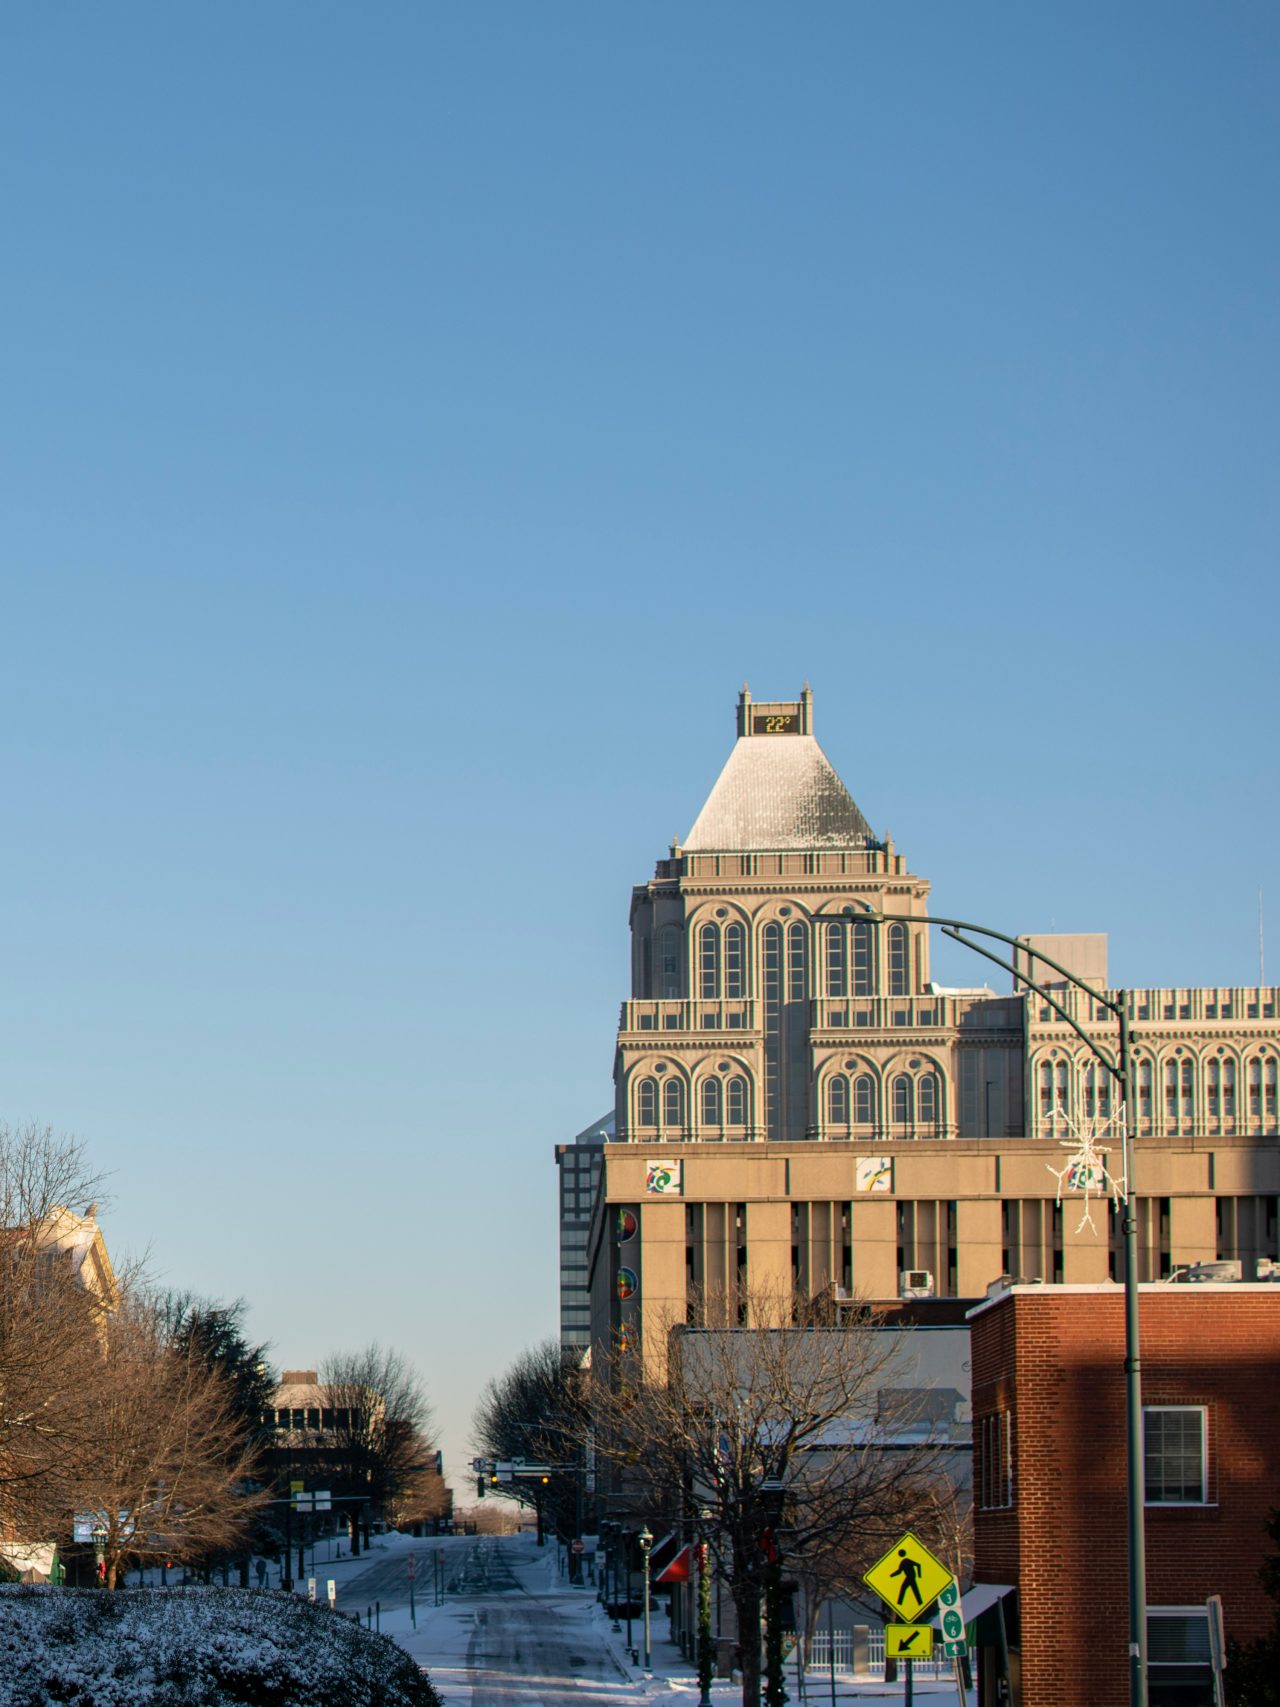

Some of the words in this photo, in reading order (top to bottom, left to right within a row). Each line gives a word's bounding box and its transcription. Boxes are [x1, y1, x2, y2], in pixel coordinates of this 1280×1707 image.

[766, 716, 792, 733] 22°
[946, 1593, 952, 1604] 3
[951, 1626, 957, 1636] 6
